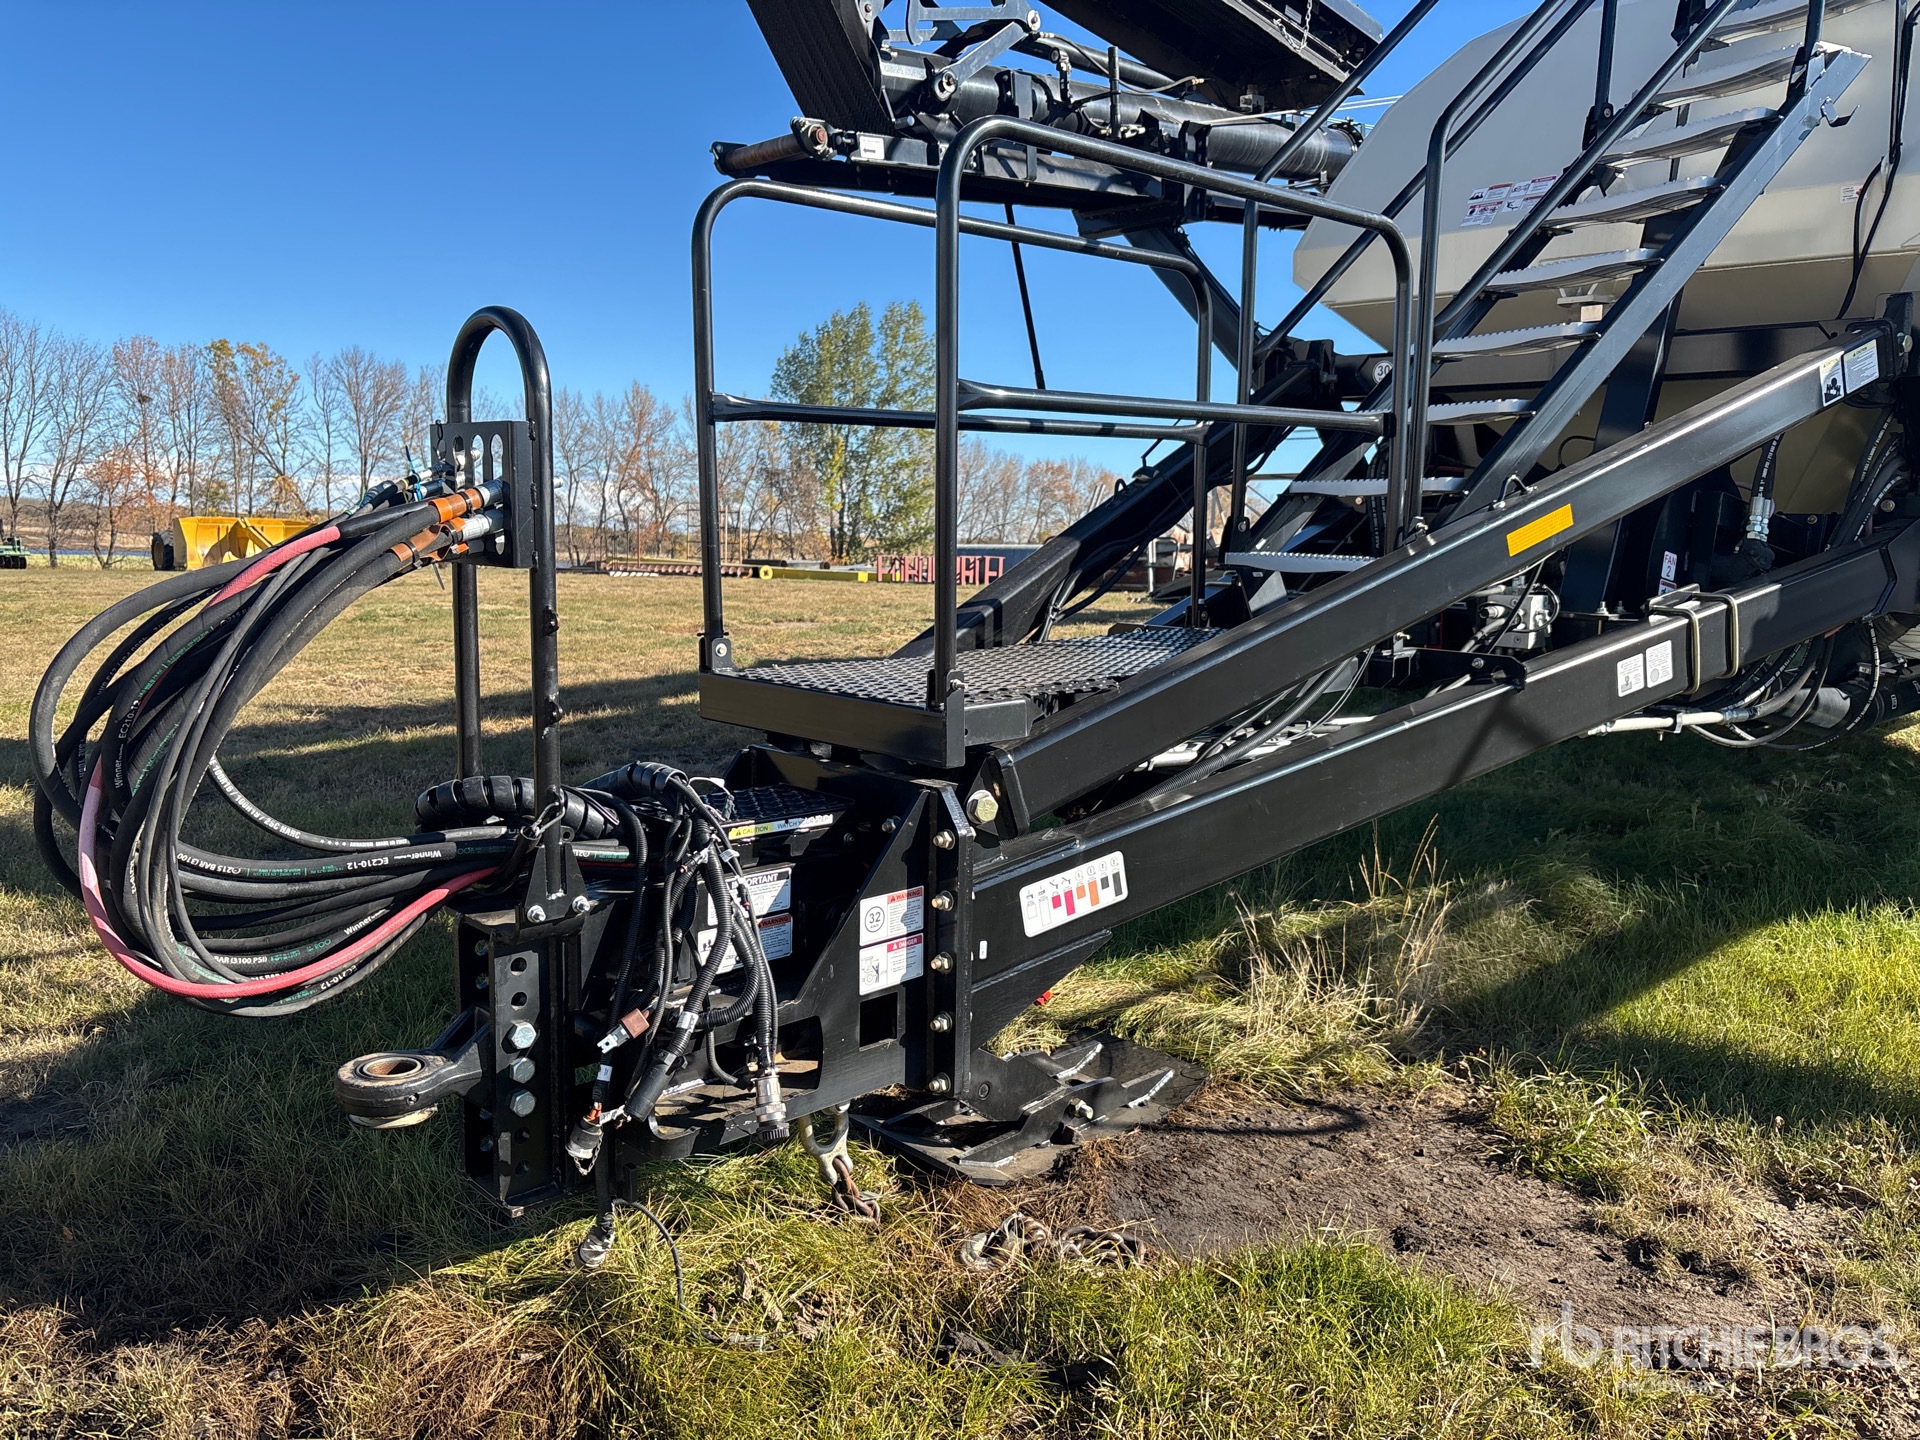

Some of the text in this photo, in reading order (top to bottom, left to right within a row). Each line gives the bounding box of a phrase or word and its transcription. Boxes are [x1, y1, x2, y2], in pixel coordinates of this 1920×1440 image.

[1664, 554, 1677, 566] FAN
[1666, 566, 1671, 577] 2
[118, 700, 141, 739] EC210-12
[114, 759, 123, 788] Winner
[742, 825, 768, 835] CAUTION
[777, 821, 797, 829] WATCH
[411, 850, 442, 859] Winner
[177, 853, 232, 874] 215 BAR (3100
[347, 856, 389, 870] EC210-12
[731, 873, 779, 887] IMORTANT
[896, 889, 921, 901] WARNING
[762, 916, 789, 927] WARNING
[869, 911, 881, 924] 32
[343, 915, 372, 935] Winner
[898, 938, 918, 949] DANGER
[230, 956, 252, 964] (3100
[252, 956, 267, 964] PSI)
